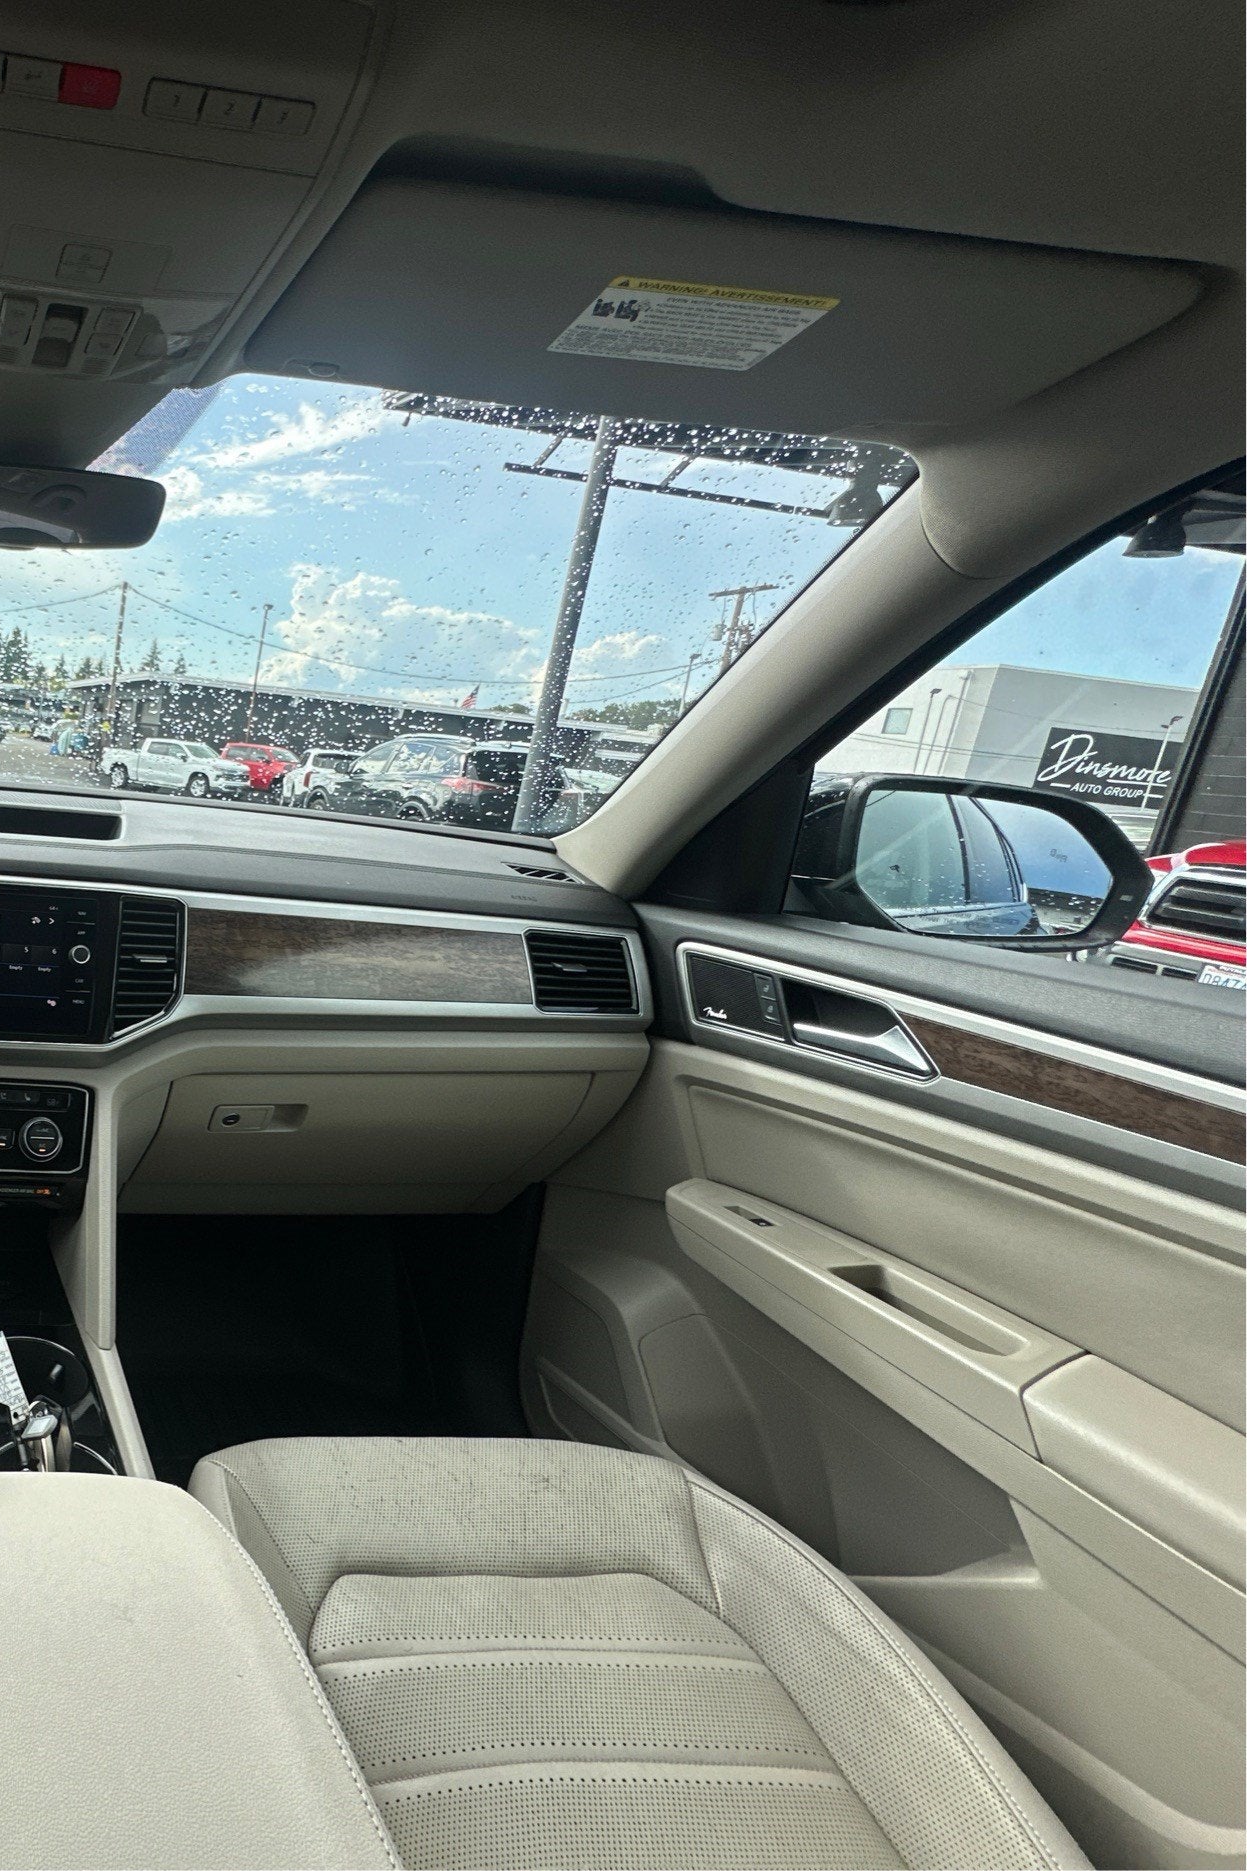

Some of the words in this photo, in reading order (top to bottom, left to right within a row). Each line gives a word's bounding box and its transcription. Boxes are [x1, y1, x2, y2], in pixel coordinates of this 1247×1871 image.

[638, 281, 709, 295] WARNING!
[710, 289, 827, 307] AVERTISSEMENT!
[1037, 733, 1172, 783] Dinsmore
[1070, 782, 1102, 794] AUTO
[1103, 786, 1144, 799] GROUP
